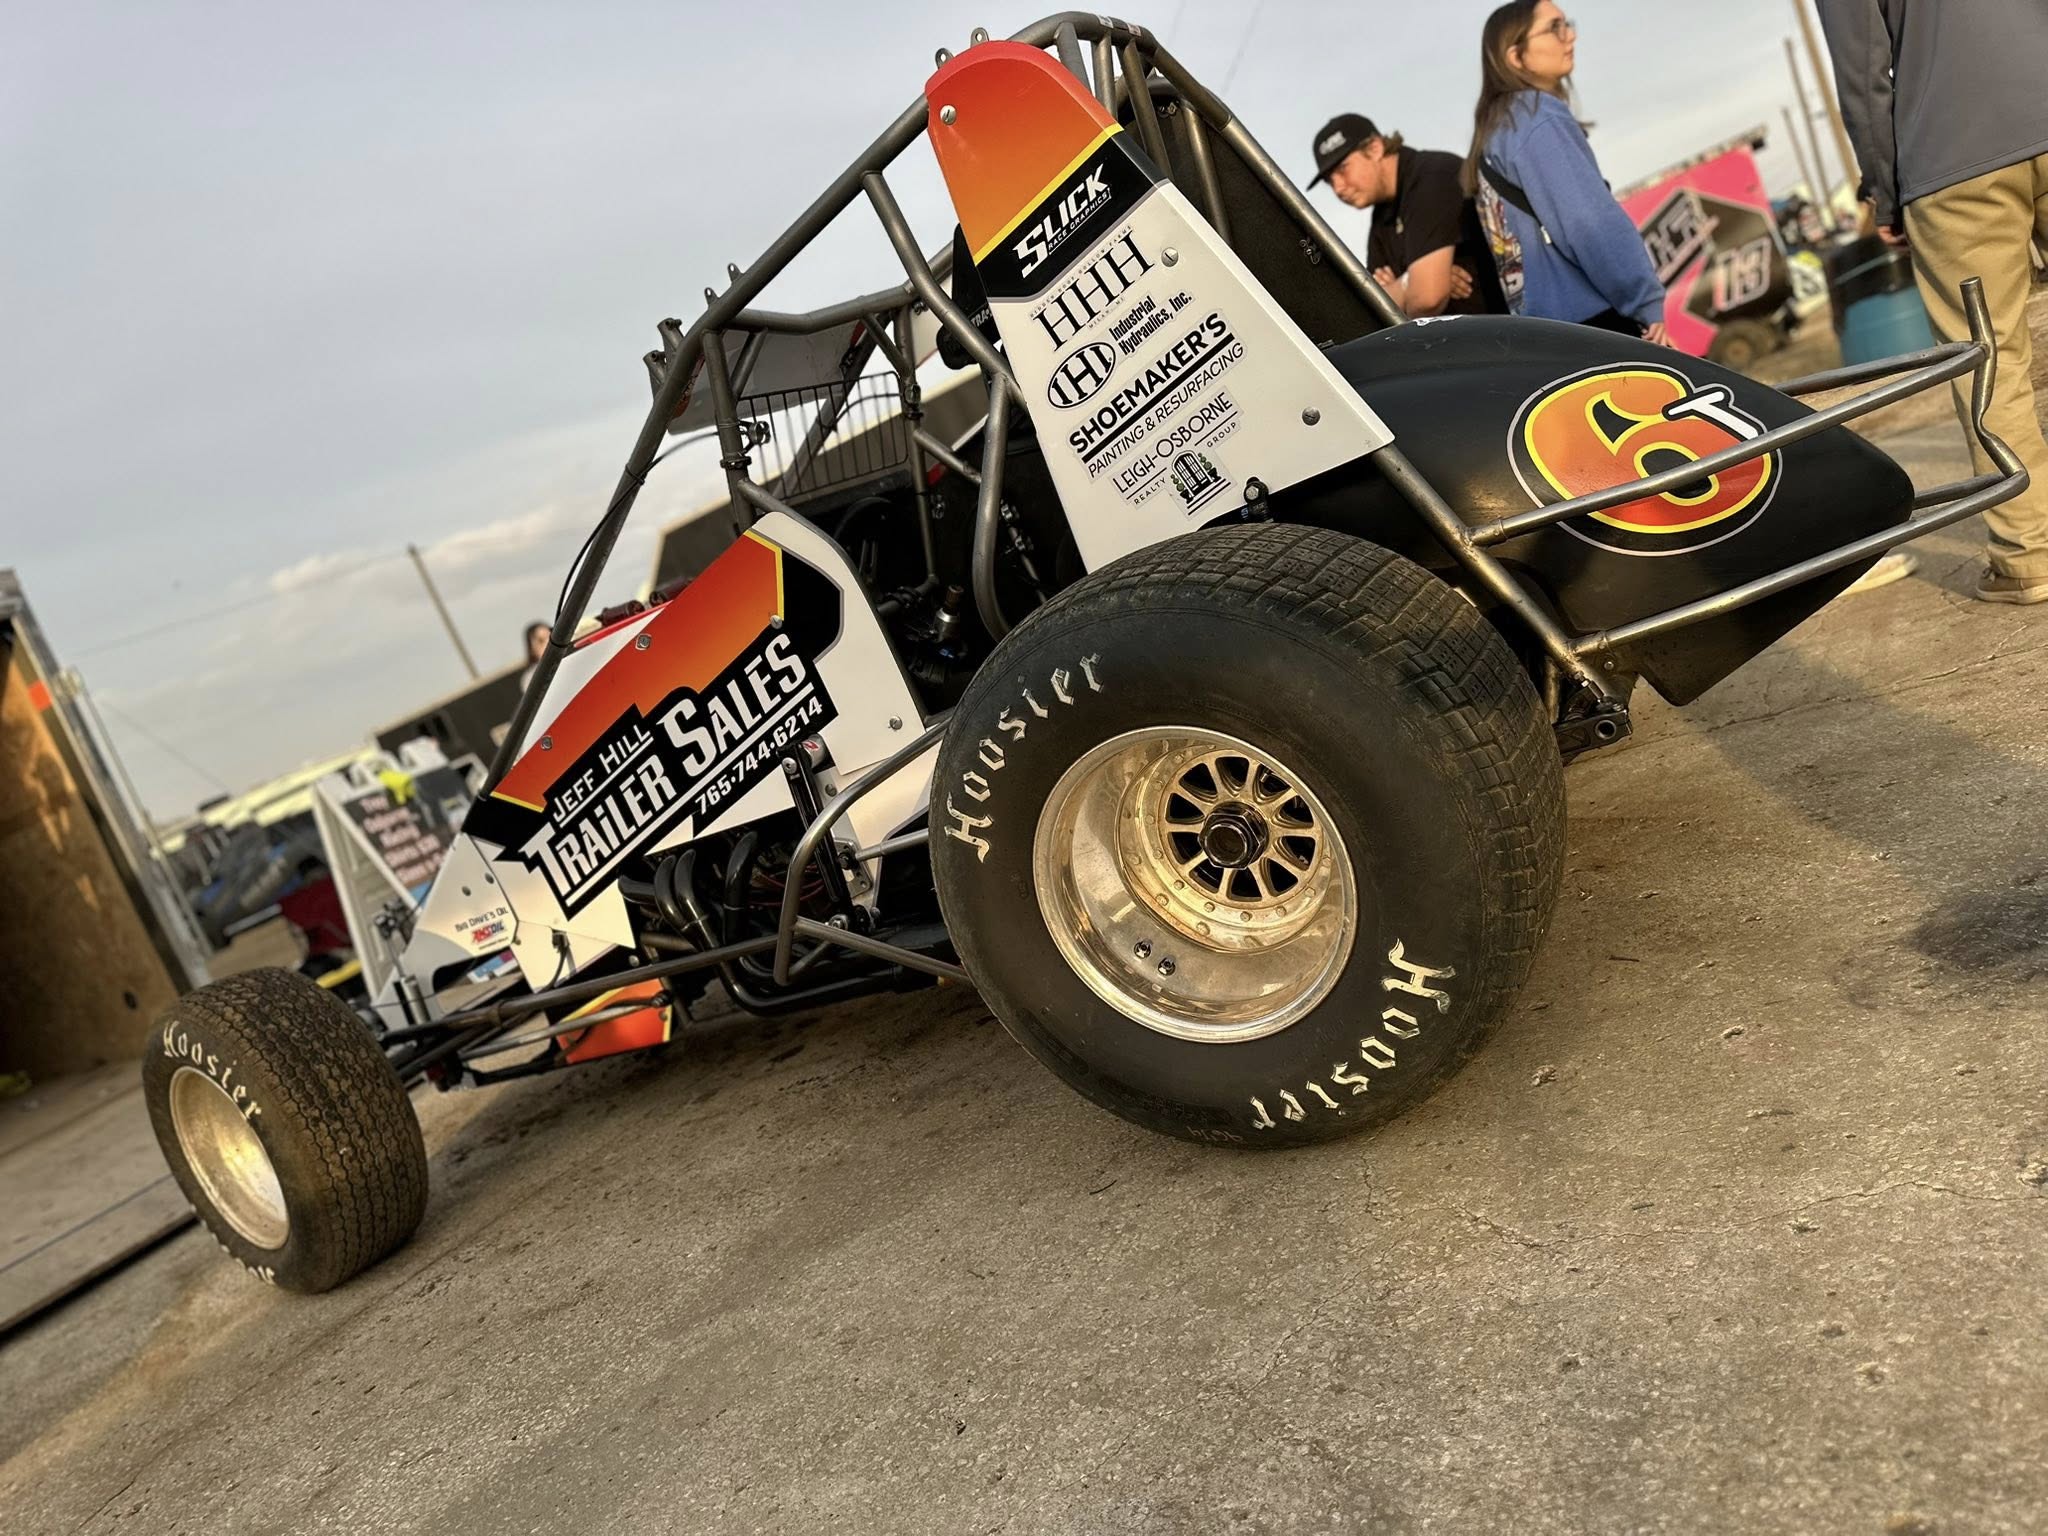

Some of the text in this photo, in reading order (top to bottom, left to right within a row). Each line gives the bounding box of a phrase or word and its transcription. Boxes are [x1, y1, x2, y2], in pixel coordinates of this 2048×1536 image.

[1012, 163, 1108, 279] SLICK
[1048, 191, 1108, 250] RACE GRAPHICS
[1032, 230, 1155, 352] HHH
[1108, 295, 1157, 342] Industrial
[1118, 292, 1192, 356] Hydraulics, Inc.
[1051, 345, 1112, 405] IHI
[1069, 312, 1227, 453] SHOEMAKER'S
[1088, 342, 1244, 478] PAINTING & RESURFACING
[1113, 391, 1233, 493] LEIGH-OSBORNE
[1133, 422, 1238, 505] REALTY GROUP
[655, 633, 806, 778] SALES
[553, 724, 652, 823] JEFF HILL
[945, 653, 1104, 863] Hoosier
[163, 1020, 262, 1120] Hoosier
[1250, 939, 1456, 1131] Hoosier
